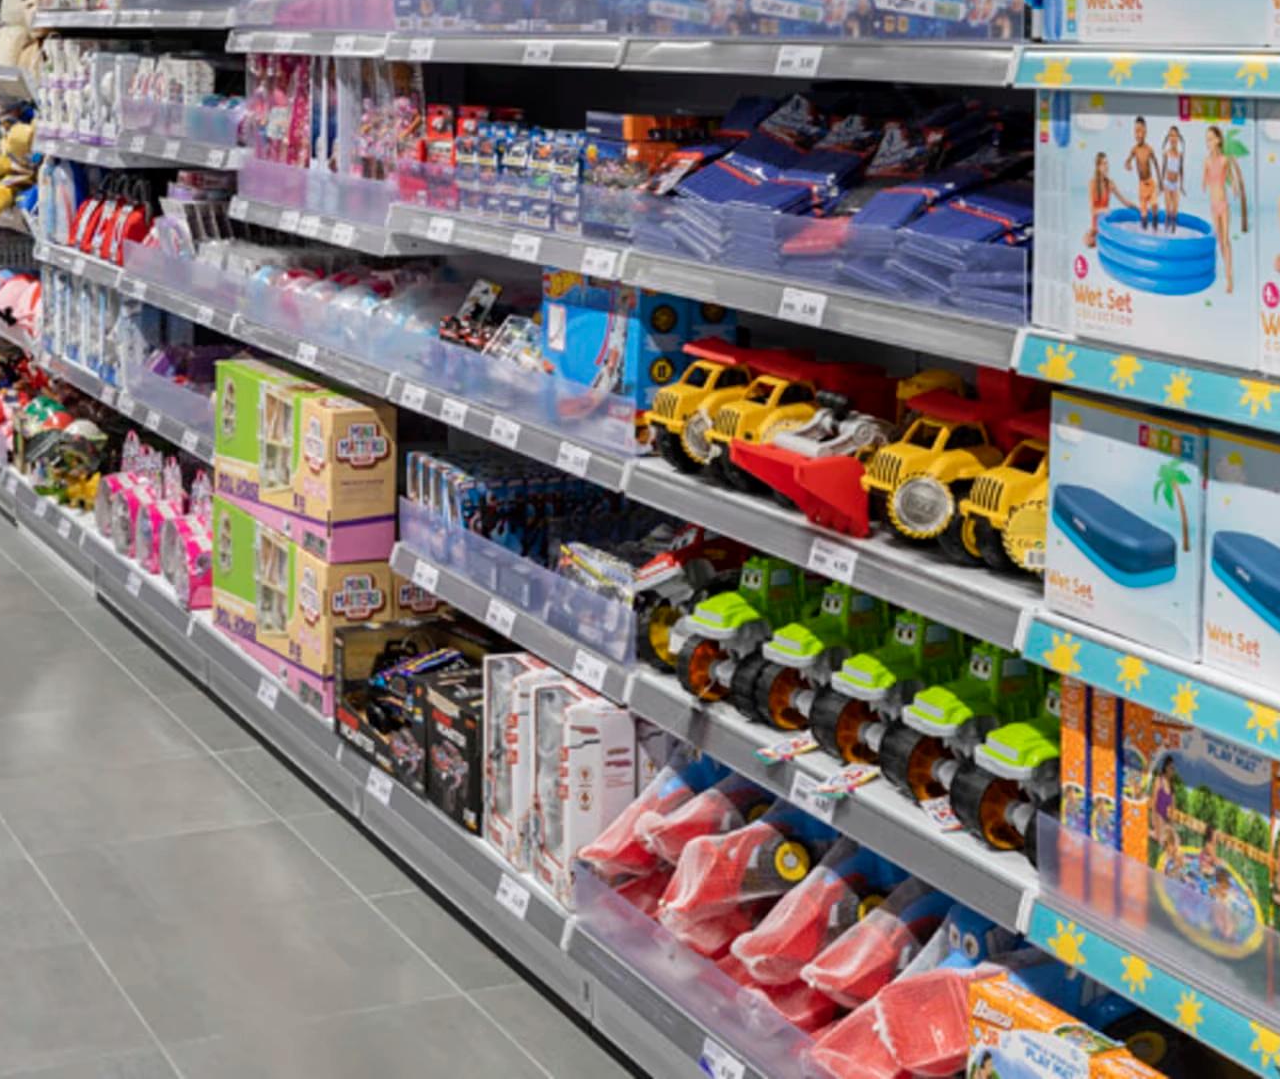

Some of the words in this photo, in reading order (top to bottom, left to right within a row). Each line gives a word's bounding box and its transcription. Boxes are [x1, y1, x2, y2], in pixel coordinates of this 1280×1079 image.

[1073, 283, 1103, 307] Wet
[1106, 291, 1133, 314] Set
[1072, 577, 1093, 601] Set
[1206, 622, 1234, 650] Wet
[1236, 634, 1261, 658] Set
